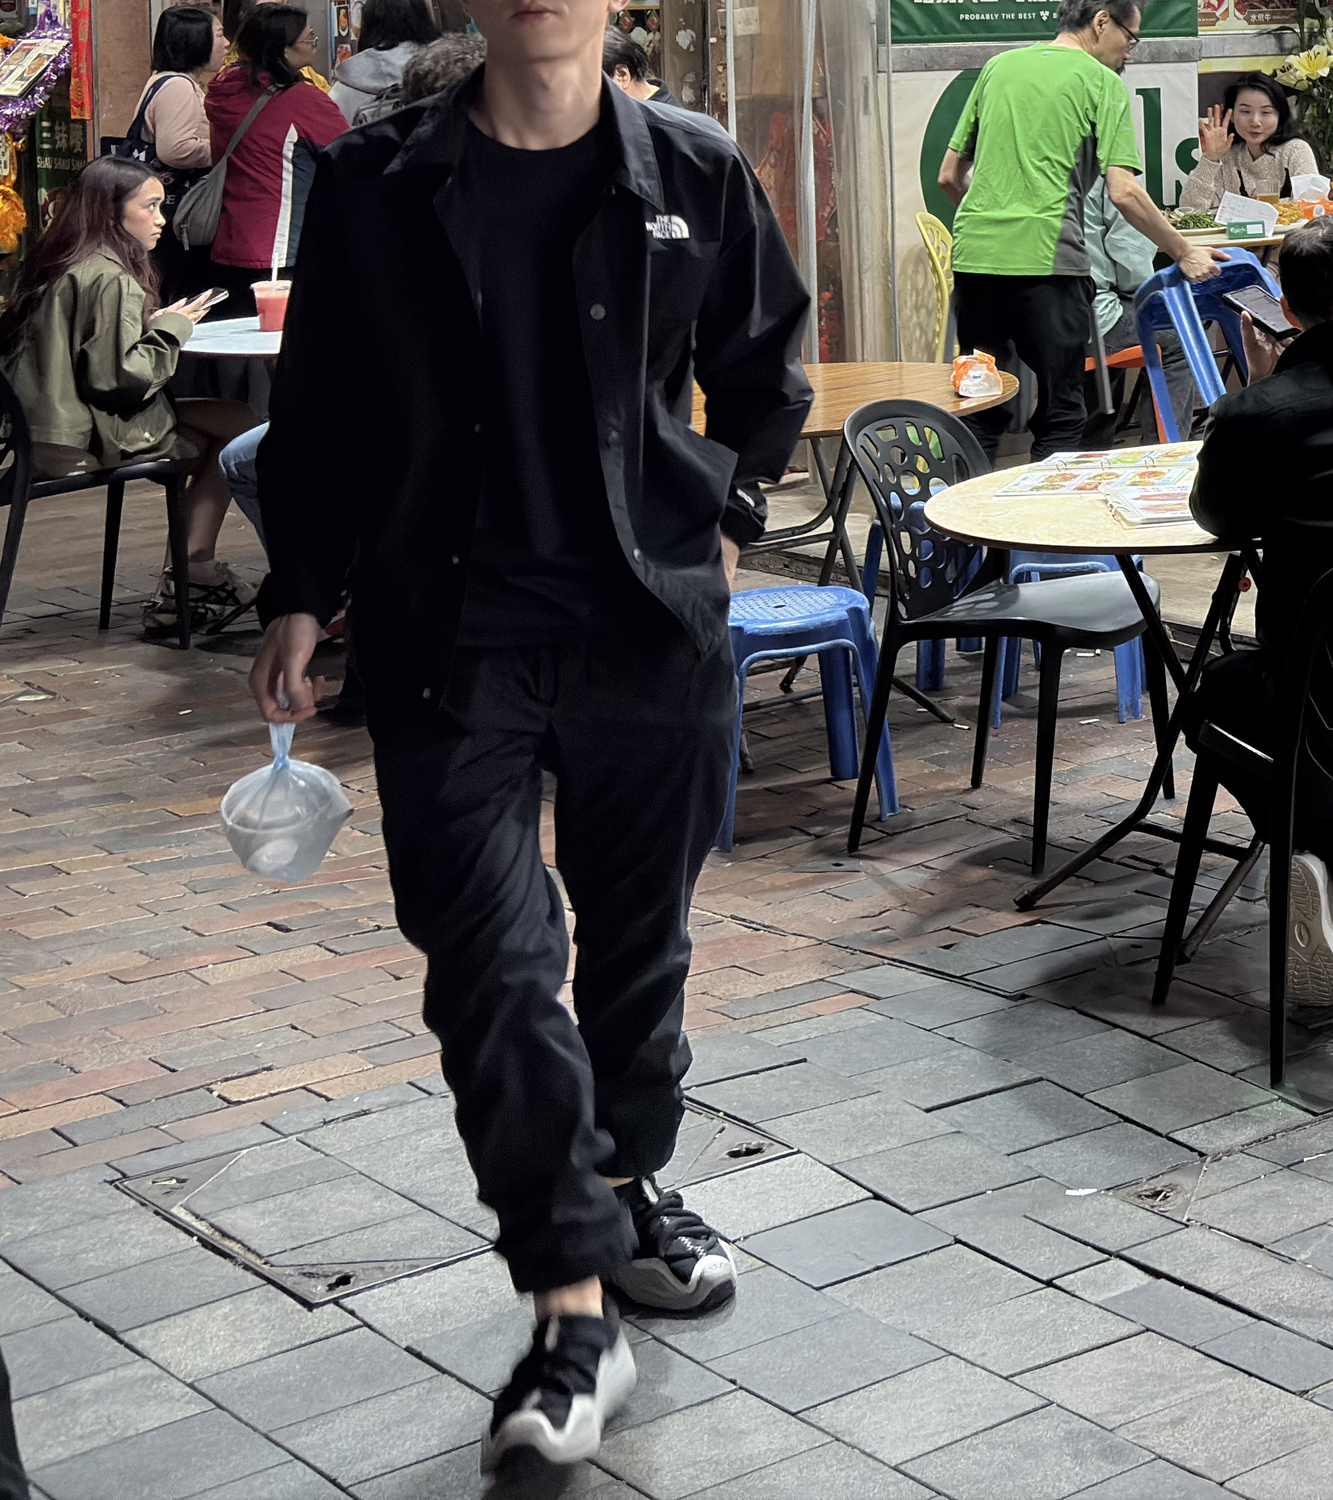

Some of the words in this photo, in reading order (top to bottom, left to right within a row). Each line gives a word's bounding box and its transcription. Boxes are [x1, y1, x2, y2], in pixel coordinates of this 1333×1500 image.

[960, 13, 999, 21] PROBABLY
[1001, 12, 1015, 20] THE
[1018, 12, 1036, 20] BEST
